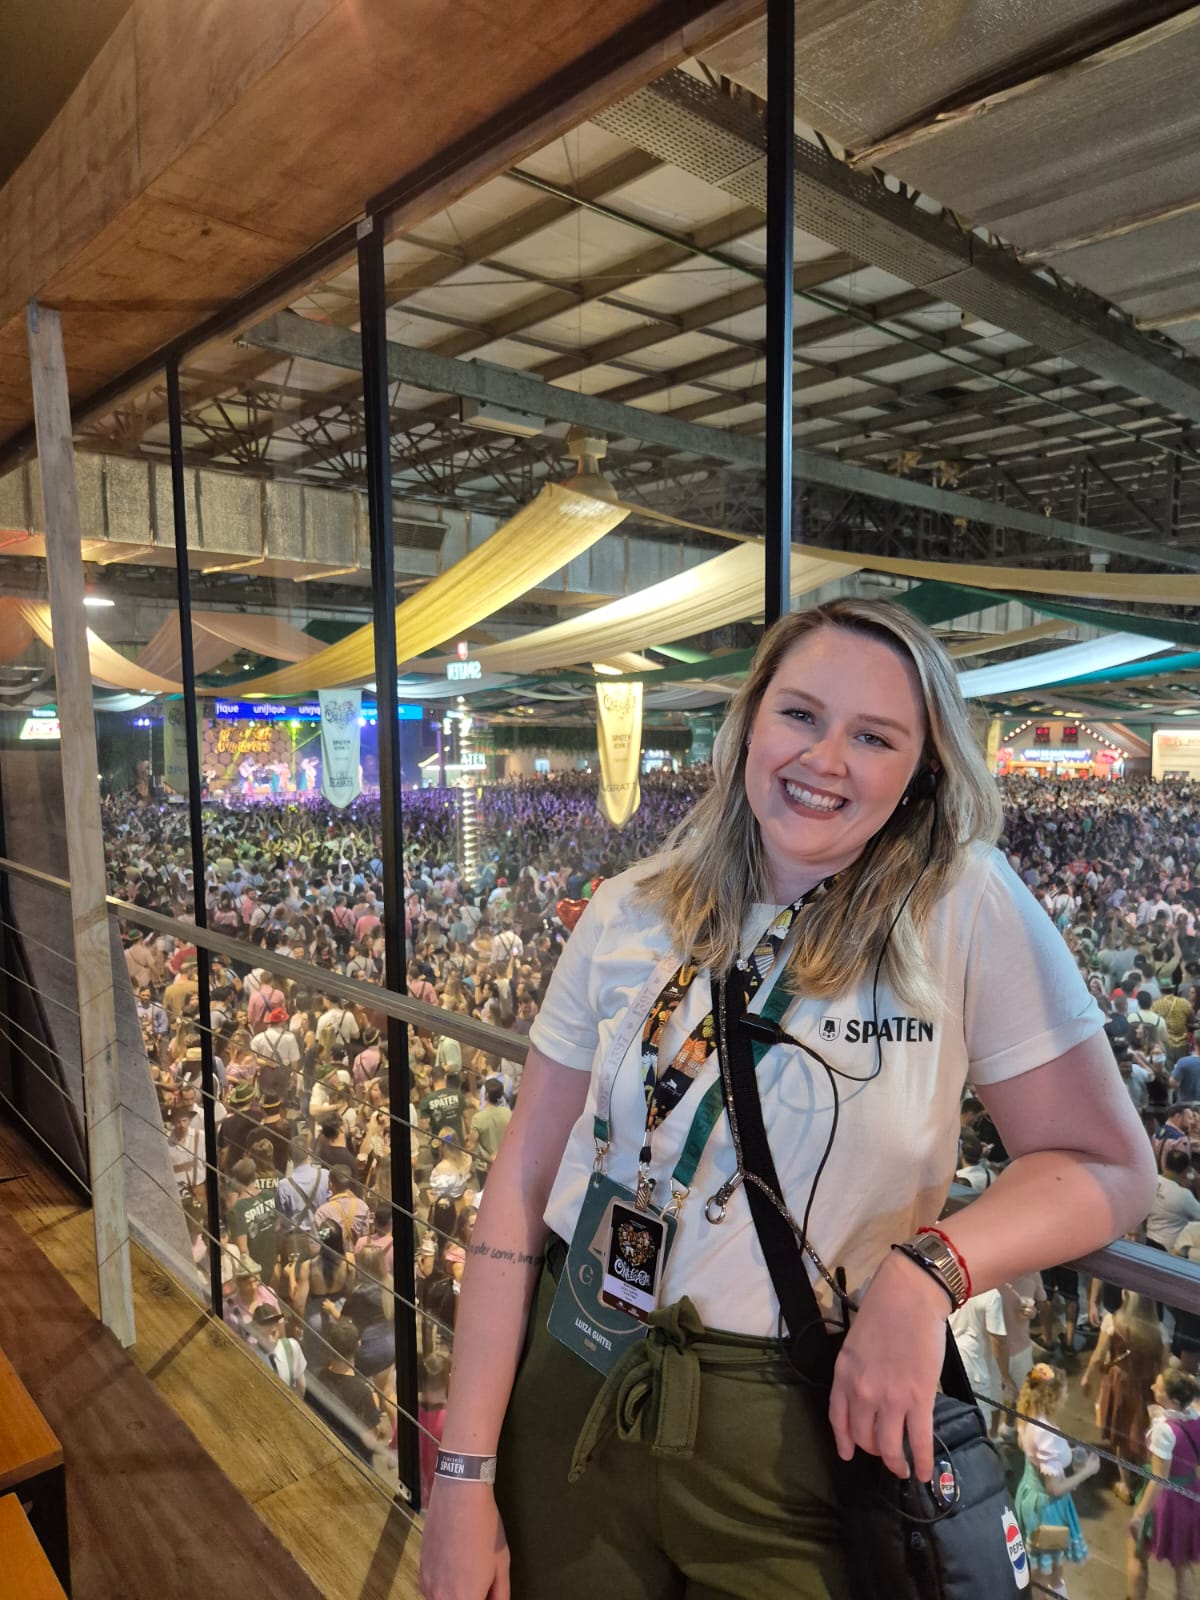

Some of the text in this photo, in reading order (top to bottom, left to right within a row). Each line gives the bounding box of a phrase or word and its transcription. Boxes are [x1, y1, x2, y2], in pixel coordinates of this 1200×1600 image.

[845, 1017, 933, 1043] SPATEN
[429, 1094, 459, 1110] SPATEN
[255, 1177, 278, 1189] ATEN
[244, 1198, 276, 1223] SPATEN
[575, 1317, 592, 1336] LUIZA
[440, 1461, 464, 1474] SPATEN
